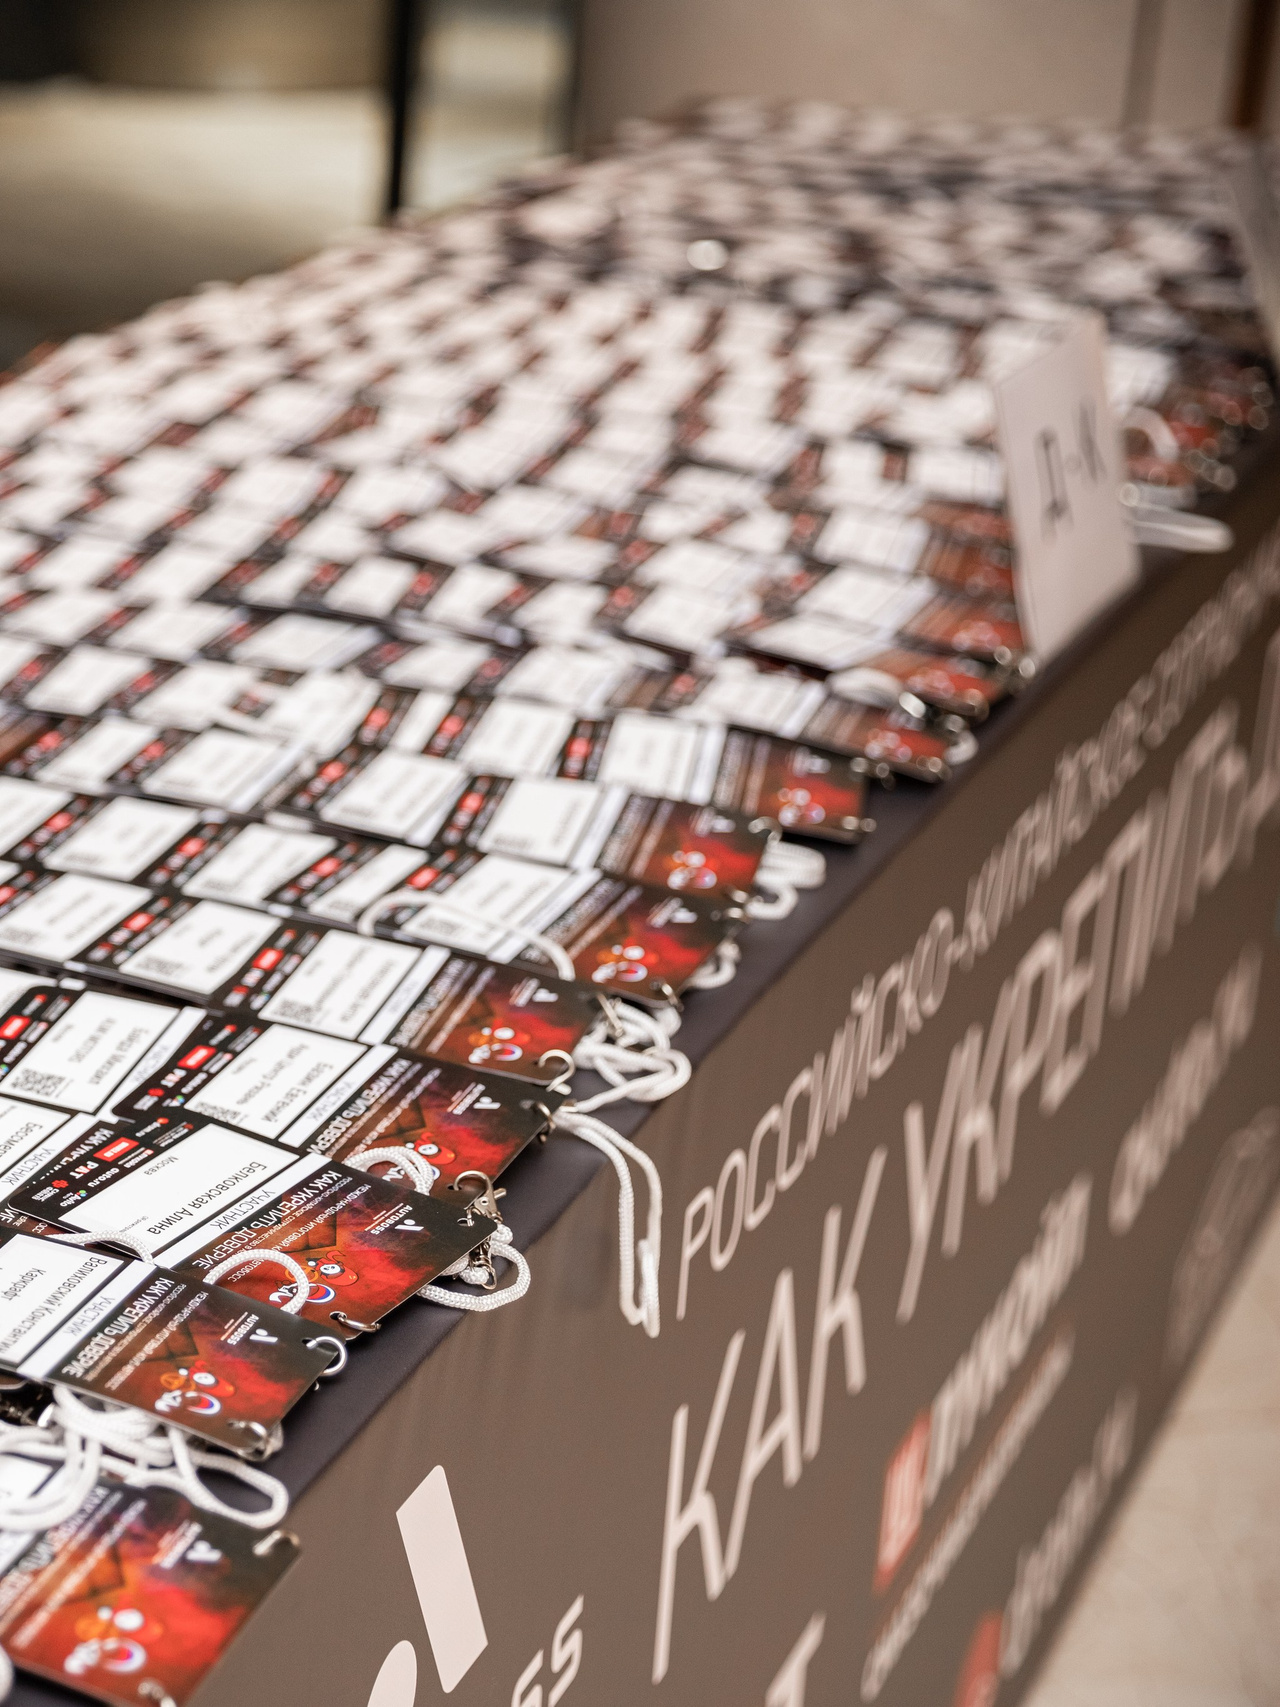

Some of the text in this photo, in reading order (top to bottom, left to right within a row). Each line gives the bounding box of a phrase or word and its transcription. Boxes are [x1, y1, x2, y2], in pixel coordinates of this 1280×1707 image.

[0, 1146, 56, 1186] УЧАСТНИК
[85, 1167, 121, 1188] auto.ru
[142, 1155, 180, 1176] Москва
[186, 1161, 268, 1209] Белковская
[58, 1193, 84, 1207] Avito
[208, 1188, 277, 1230] УЧАСТНИК
[291, 1176, 354, 1217] РОССИЙСКО-КИТАЙСКОЕ
[312, 1183, 373, 1224] МЕЖДУНАРОДНЫЙ
[145, 1207, 196, 1235] Алина
[190, 1170, 342, 1269] КАК УКРЕПИТЬ ДОВЕРИЕ
[248, 1215, 296, 1246] СОТРУДНИЧЕСТВО
[278, 1221, 318, 1247] ИТОГОВЫЙ
[369, 1204, 414, 1235] AUTOBOSS
[0, 1267, 47, 1302] Каркрафт
[40, 1256, 109, 1307] Валиховский
[59, 1277, 176, 1378] КАК УКРЕПИТЬ ДОВЕРИЕ
[62, 1295, 116, 1337] УЧАСТНИК
[225, 1313, 261, 1345] AUTOBOSS
[651, 1146, 888, 1687] КАК
